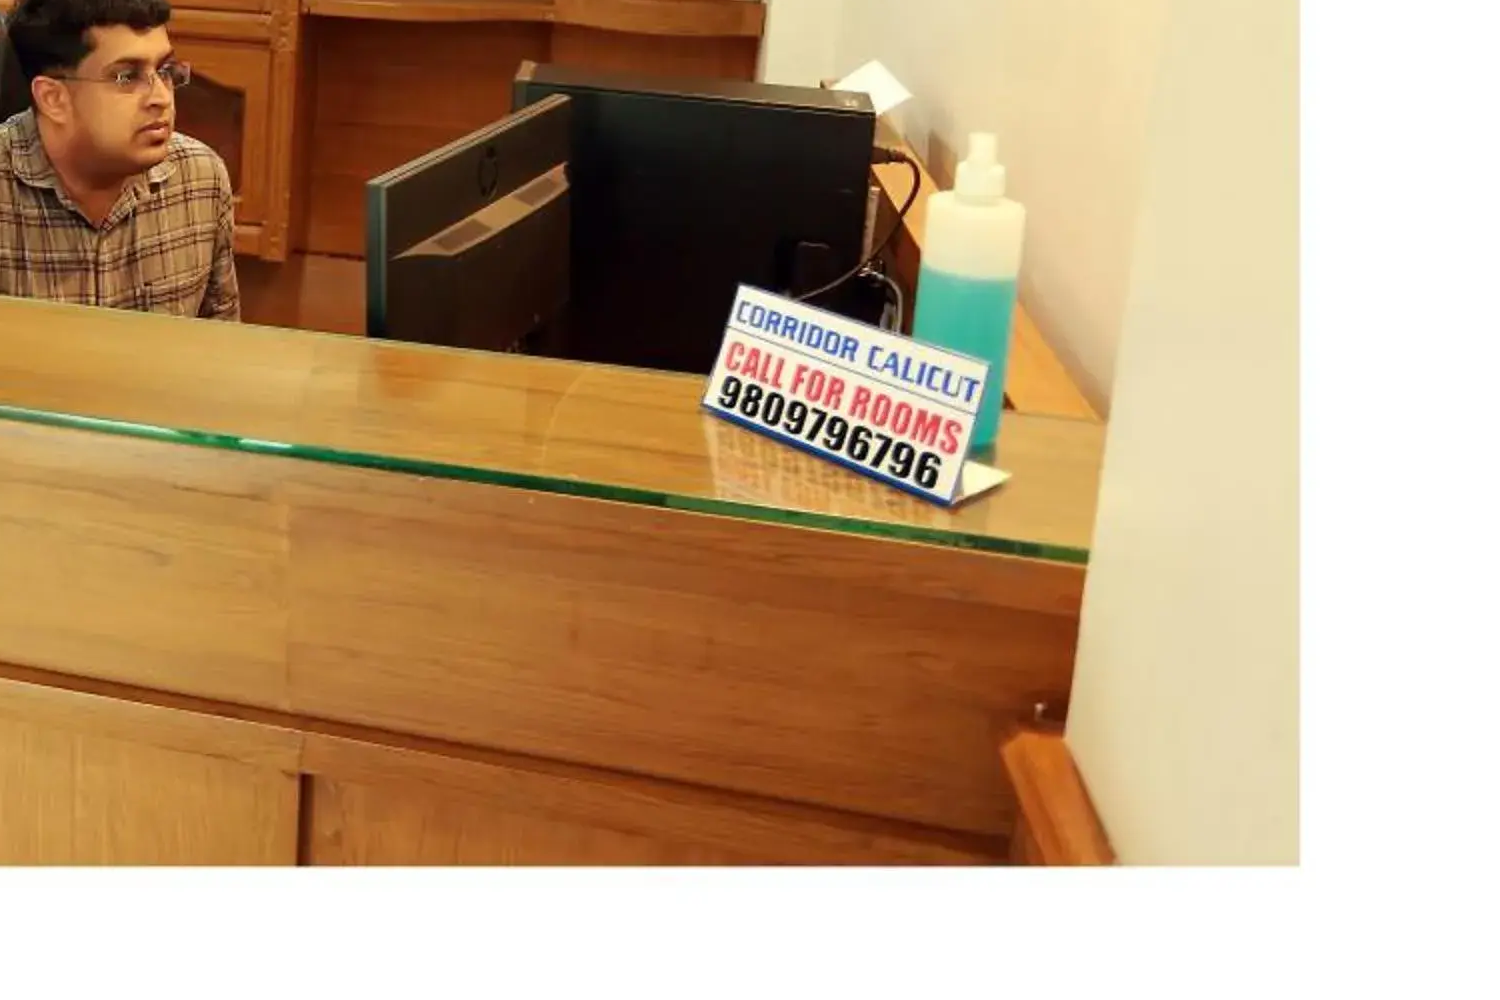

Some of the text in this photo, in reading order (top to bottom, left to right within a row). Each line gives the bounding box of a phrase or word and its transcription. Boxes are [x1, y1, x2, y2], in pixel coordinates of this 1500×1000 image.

[723, 341, 963, 454] CALL FOR ROOMS
[736, 299, 980, 402] CORRIDOR CALICUT
[718, 376, 942, 489] 9809796796
